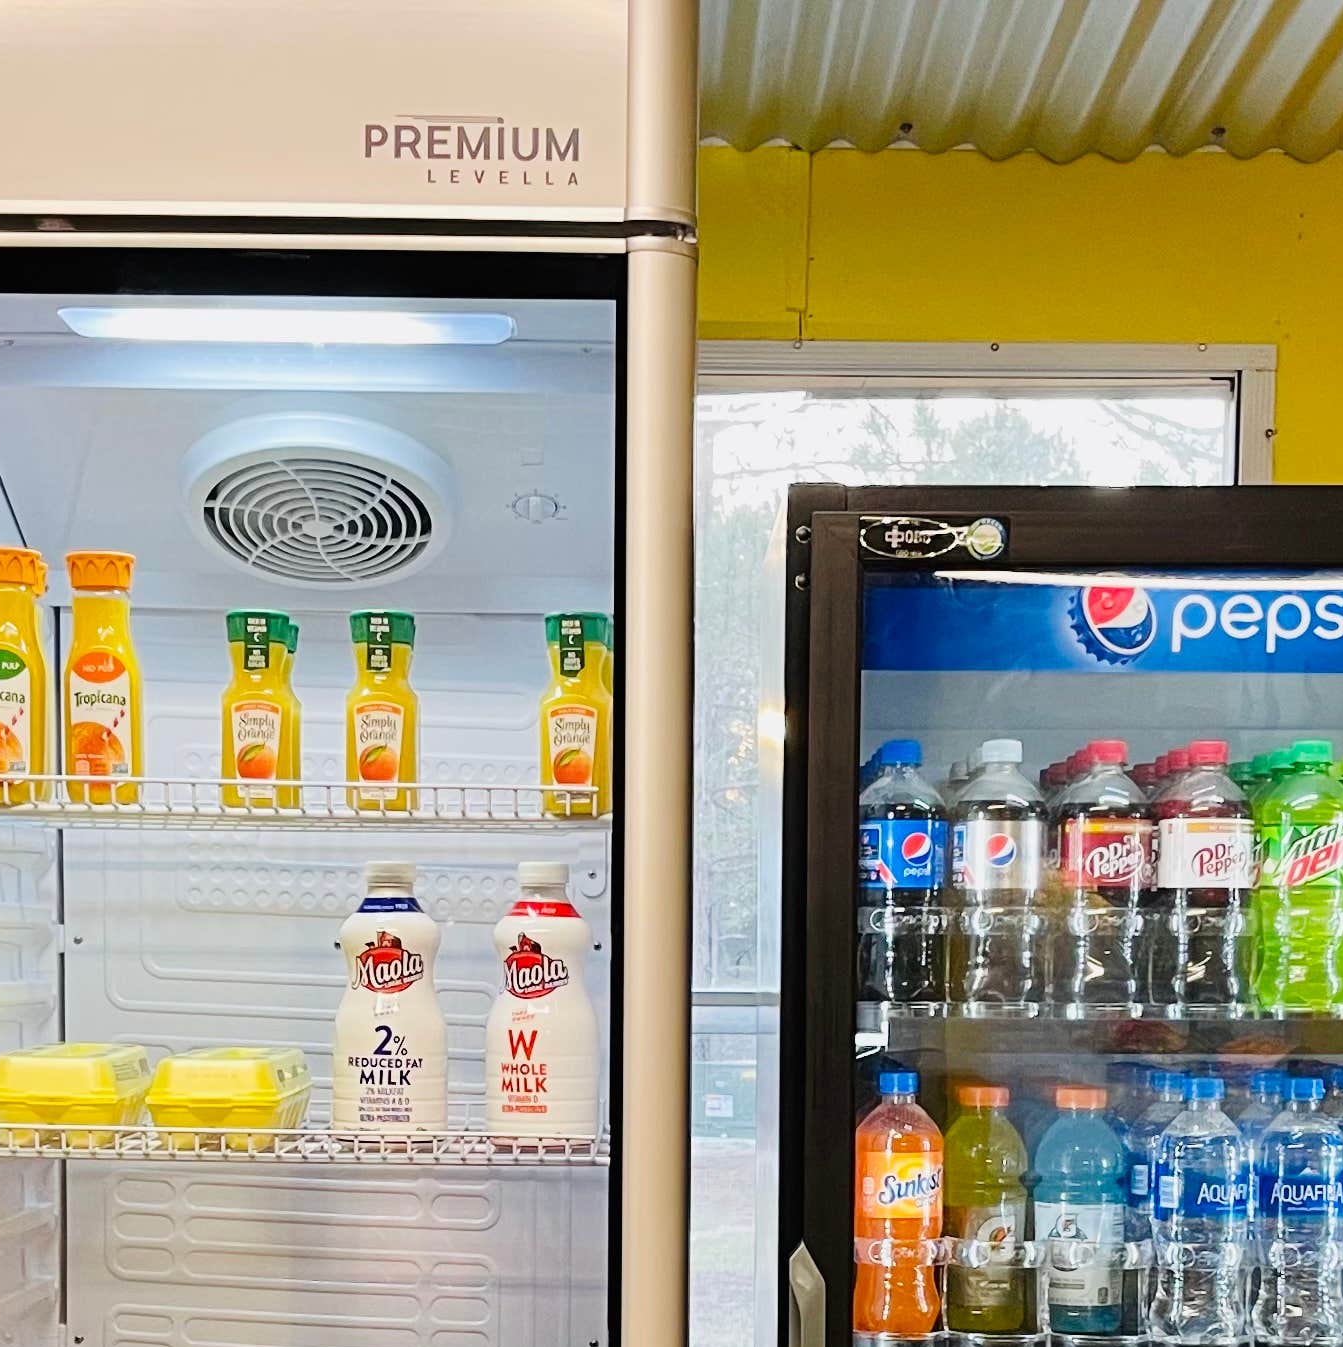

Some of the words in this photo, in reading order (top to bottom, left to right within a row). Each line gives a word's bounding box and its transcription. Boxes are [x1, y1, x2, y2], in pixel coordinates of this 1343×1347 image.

[364, 122, 580, 162] PREMIUM
[427, 168, 579, 186] LEVELLA
[1, 660, 21, 671] PULP
[73, 690, 127, 708] Tropicana
[238, 711, 276, 730] Simply
[360, 714, 398, 732] Simply
[554, 717, 591, 734] Simply
[1214, 842, 1234, 859] Dr
[1087, 846, 1143, 879] Pepper
[1193, 846, 1246, 879] Pepper
[351, 952, 424, 990] Maola
[373, 1025, 408, 1056] 2%
[508, 1029, 538, 1061] W
[348, 1056, 403, 1069] REDUCED
[406, 1057, 424, 1068] FAT
[501, 1063, 547, 1076] WHOLE
[360, 1069, 411, 1086] MILK
[501, 1077, 548, 1093] MILK
